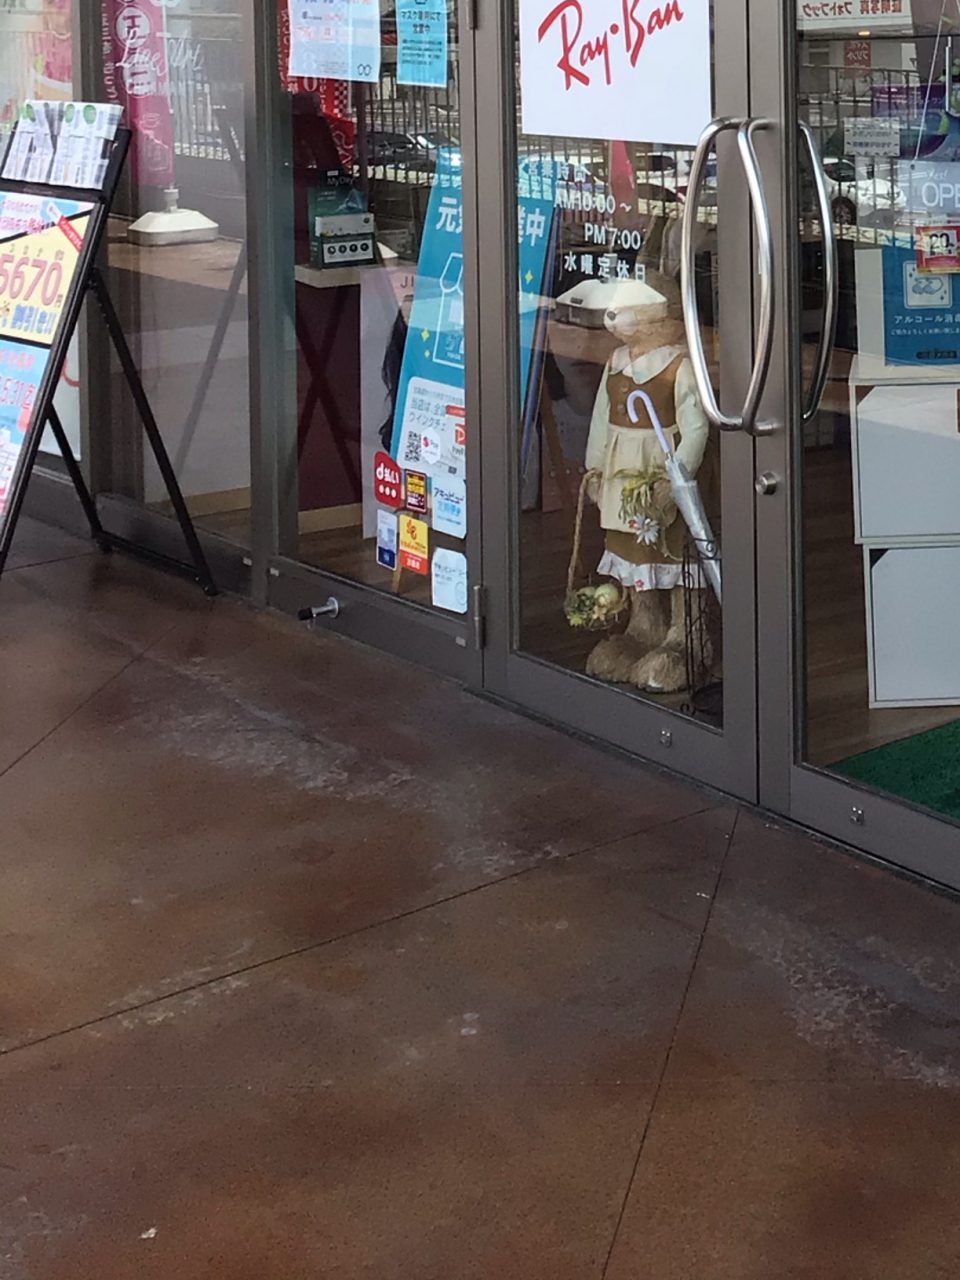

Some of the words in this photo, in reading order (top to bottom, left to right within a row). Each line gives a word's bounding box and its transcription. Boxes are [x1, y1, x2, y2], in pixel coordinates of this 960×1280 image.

[584, 222, 606, 246] PM
[607, 227, 642, 250] 7:00
[564, 251, 646, 283] 水曜定休日
